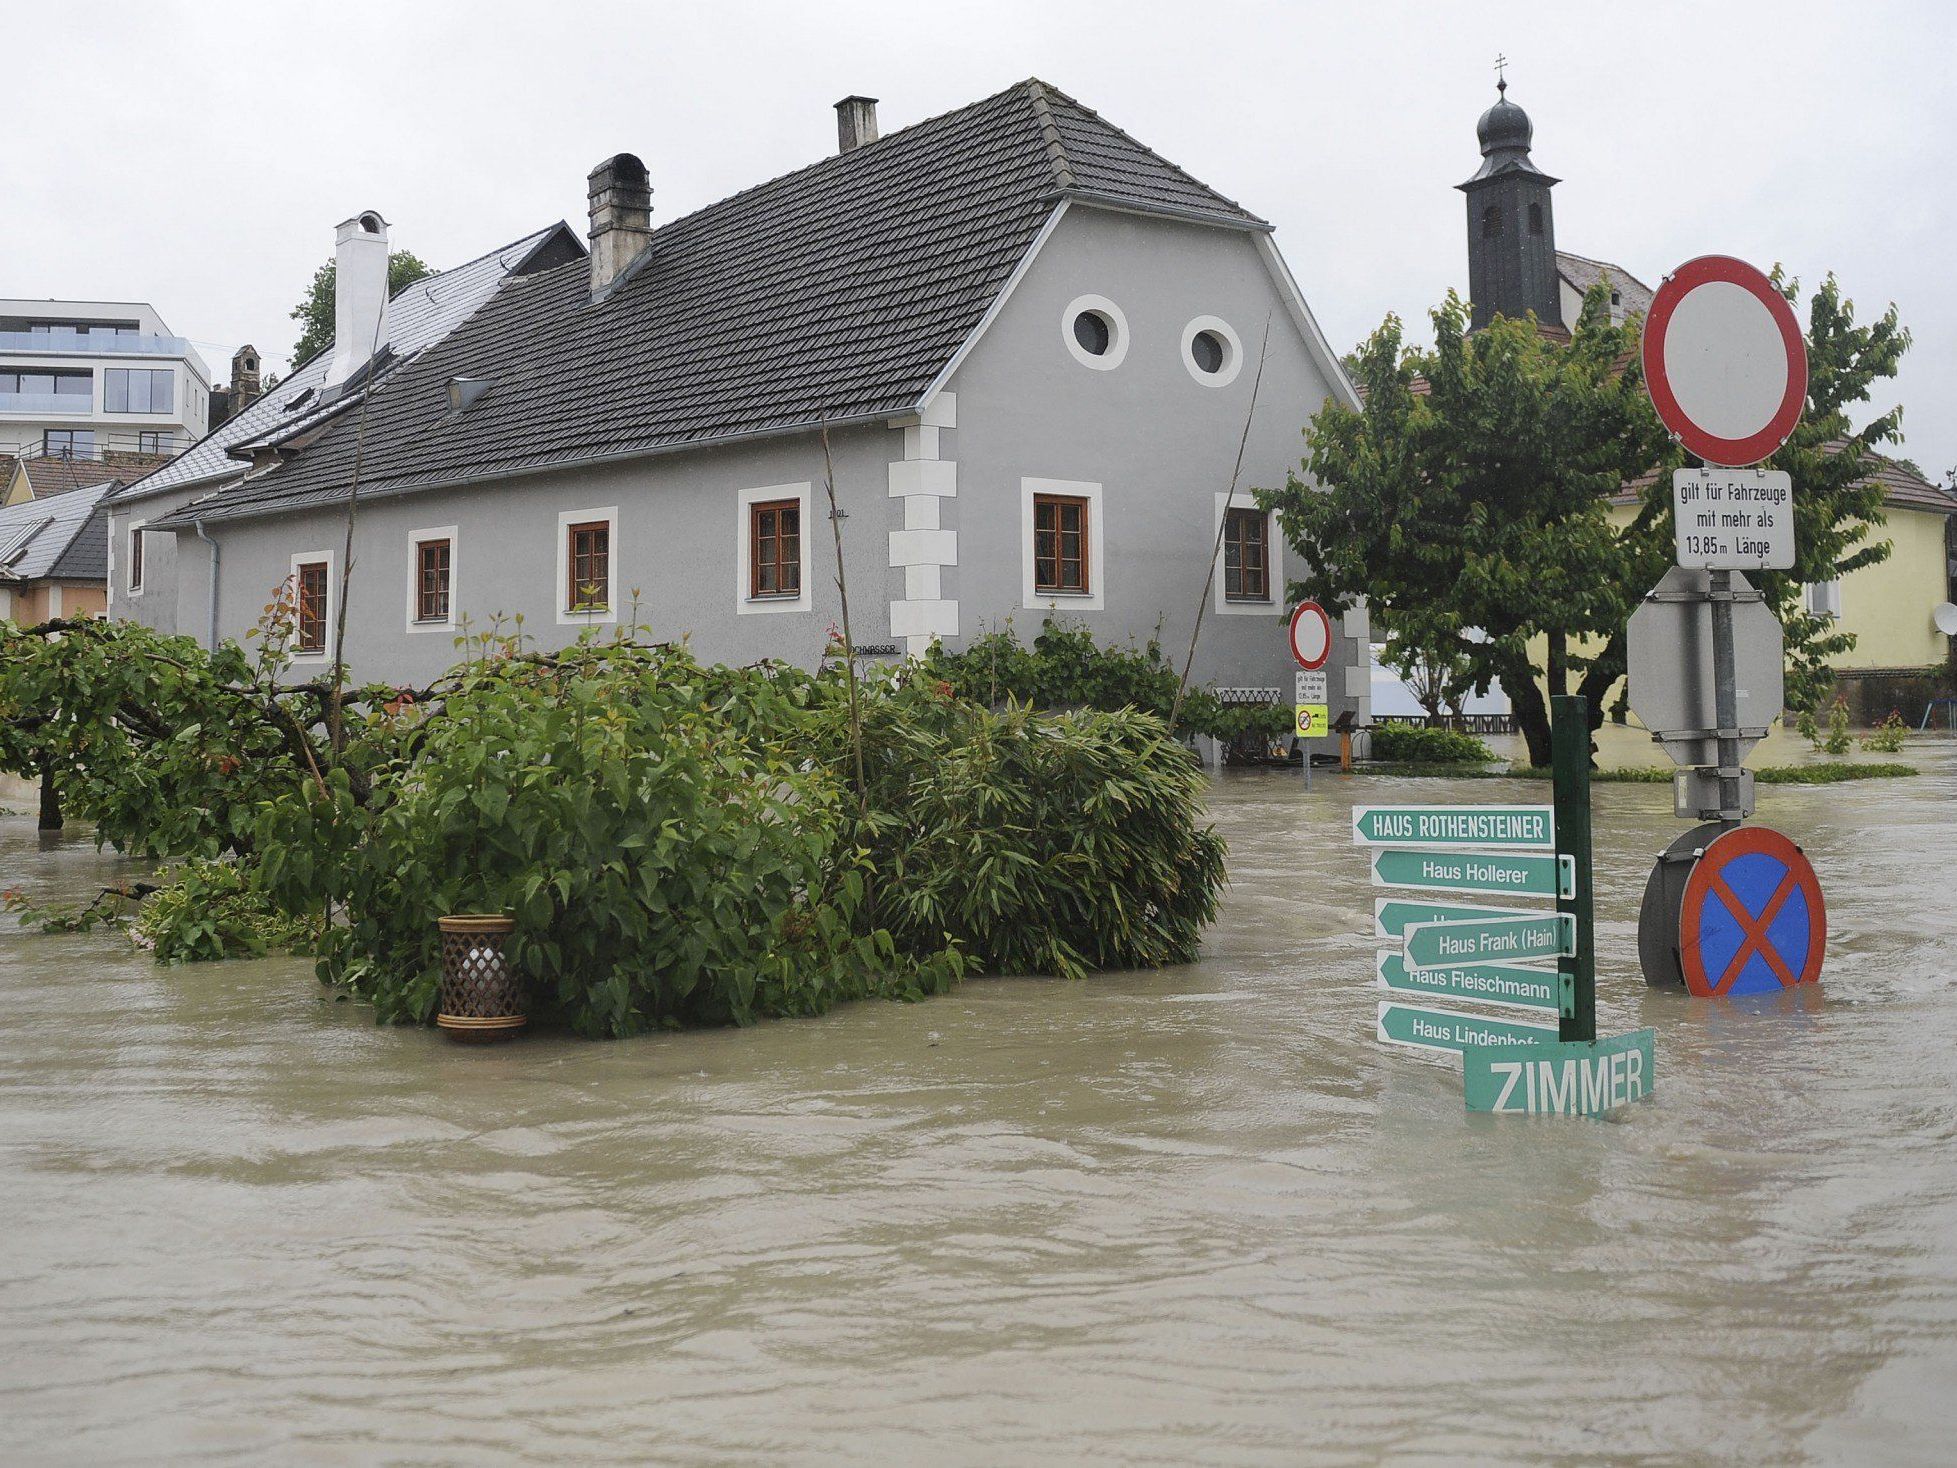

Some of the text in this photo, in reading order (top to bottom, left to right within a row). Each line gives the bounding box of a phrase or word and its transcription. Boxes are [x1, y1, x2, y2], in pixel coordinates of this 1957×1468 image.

[1681, 482, 1786, 505] gilt für Fahrzeuge
[1697, 509, 1774, 527] mit mehr als
[1736, 536, 1770, 558] Länge
[1373, 814, 1544, 839] HAUS ROTHENSTEINER
[1422, 861, 1528, 884] Haus Hollerer
[1439, 925, 1557, 955] Haus Frank (Hain)
[1409, 970, 1551, 999] Haus Fleischmann
[1413, 1018, 1450, 1041] Haus
[1490, 1048, 1644, 1114] ZIMMER
